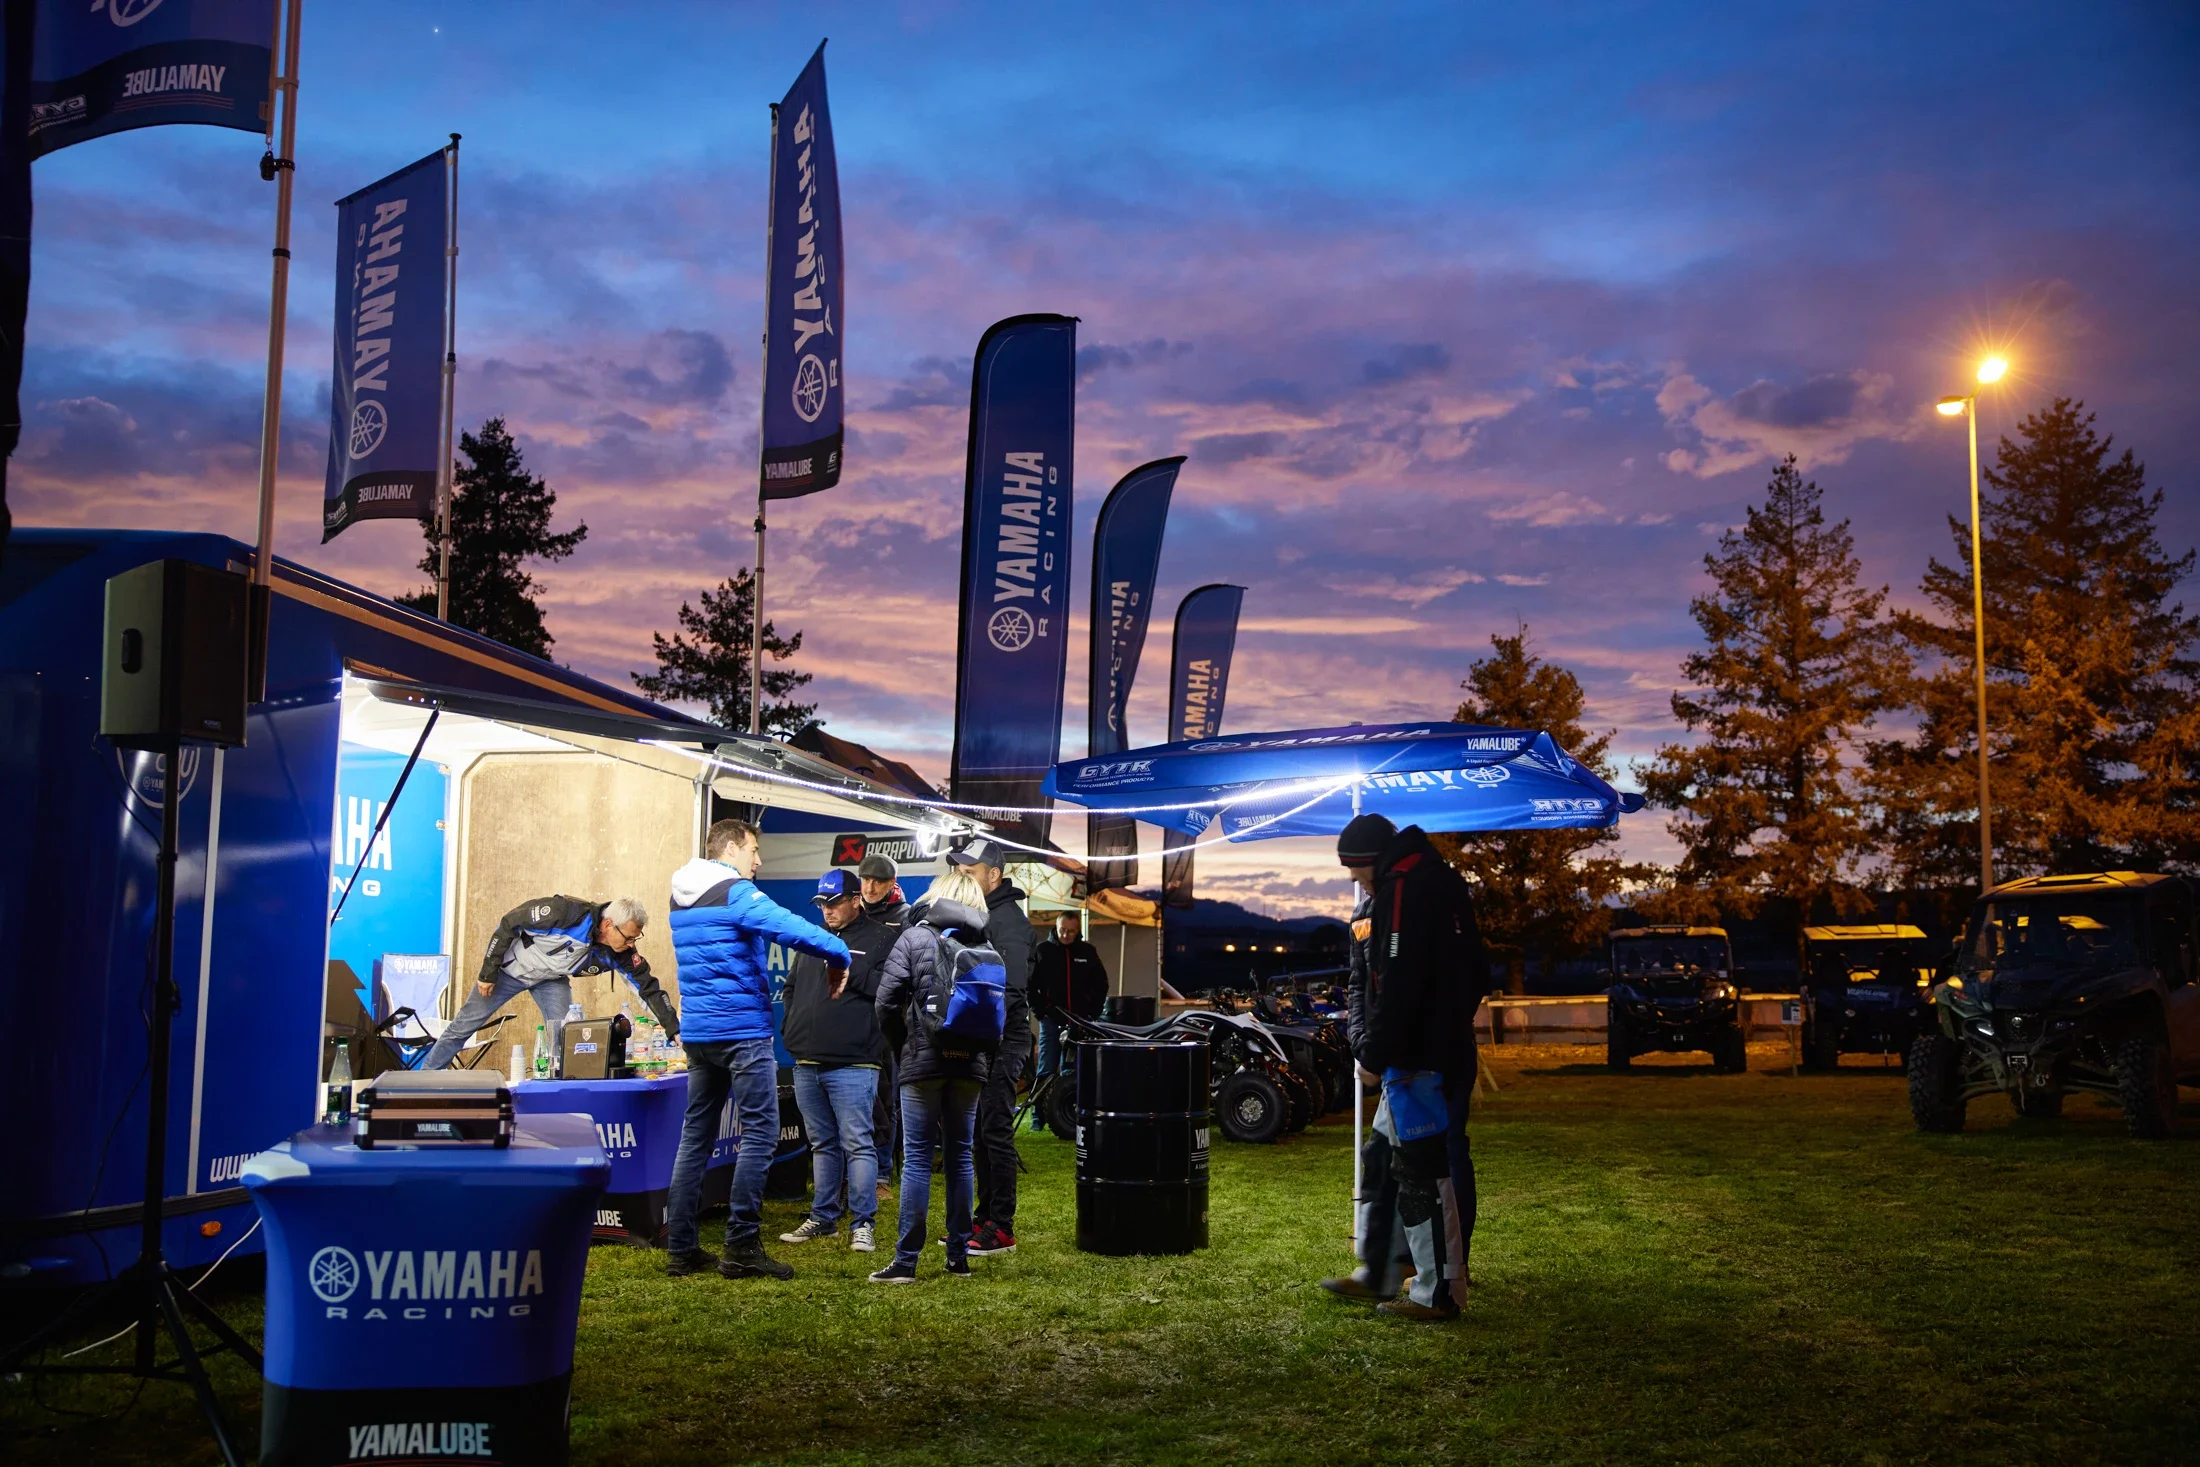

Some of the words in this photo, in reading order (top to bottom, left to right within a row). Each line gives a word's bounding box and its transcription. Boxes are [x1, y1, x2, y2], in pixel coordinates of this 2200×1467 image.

[794, 102, 824, 353] YAMAHA
[765, 458, 812, 479] YAMALUBE
[993, 452, 1044, 602] YAMAHA
[1038, 465, 1057, 637] RACING
[1183, 660, 1211, 741] AMAHA
[1248, 729, 1430, 749] YAMAHA
[1077, 759, 1156, 779] GYTR
[1073, 780, 1119, 788] PERFORMANCE
[1389, 932, 1399, 958] YAMAHA
[404, 959, 438, 970] YAMAHA
[417, 1123, 451, 1132] YAMALUBE
[1406, 1122, 1437, 1136] YAMAHA
[364, 1249, 543, 1300] YAMAHA
[326, 1304, 531, 1319] RACING
[349, 1422, 492, 1458] YAMALUBE
